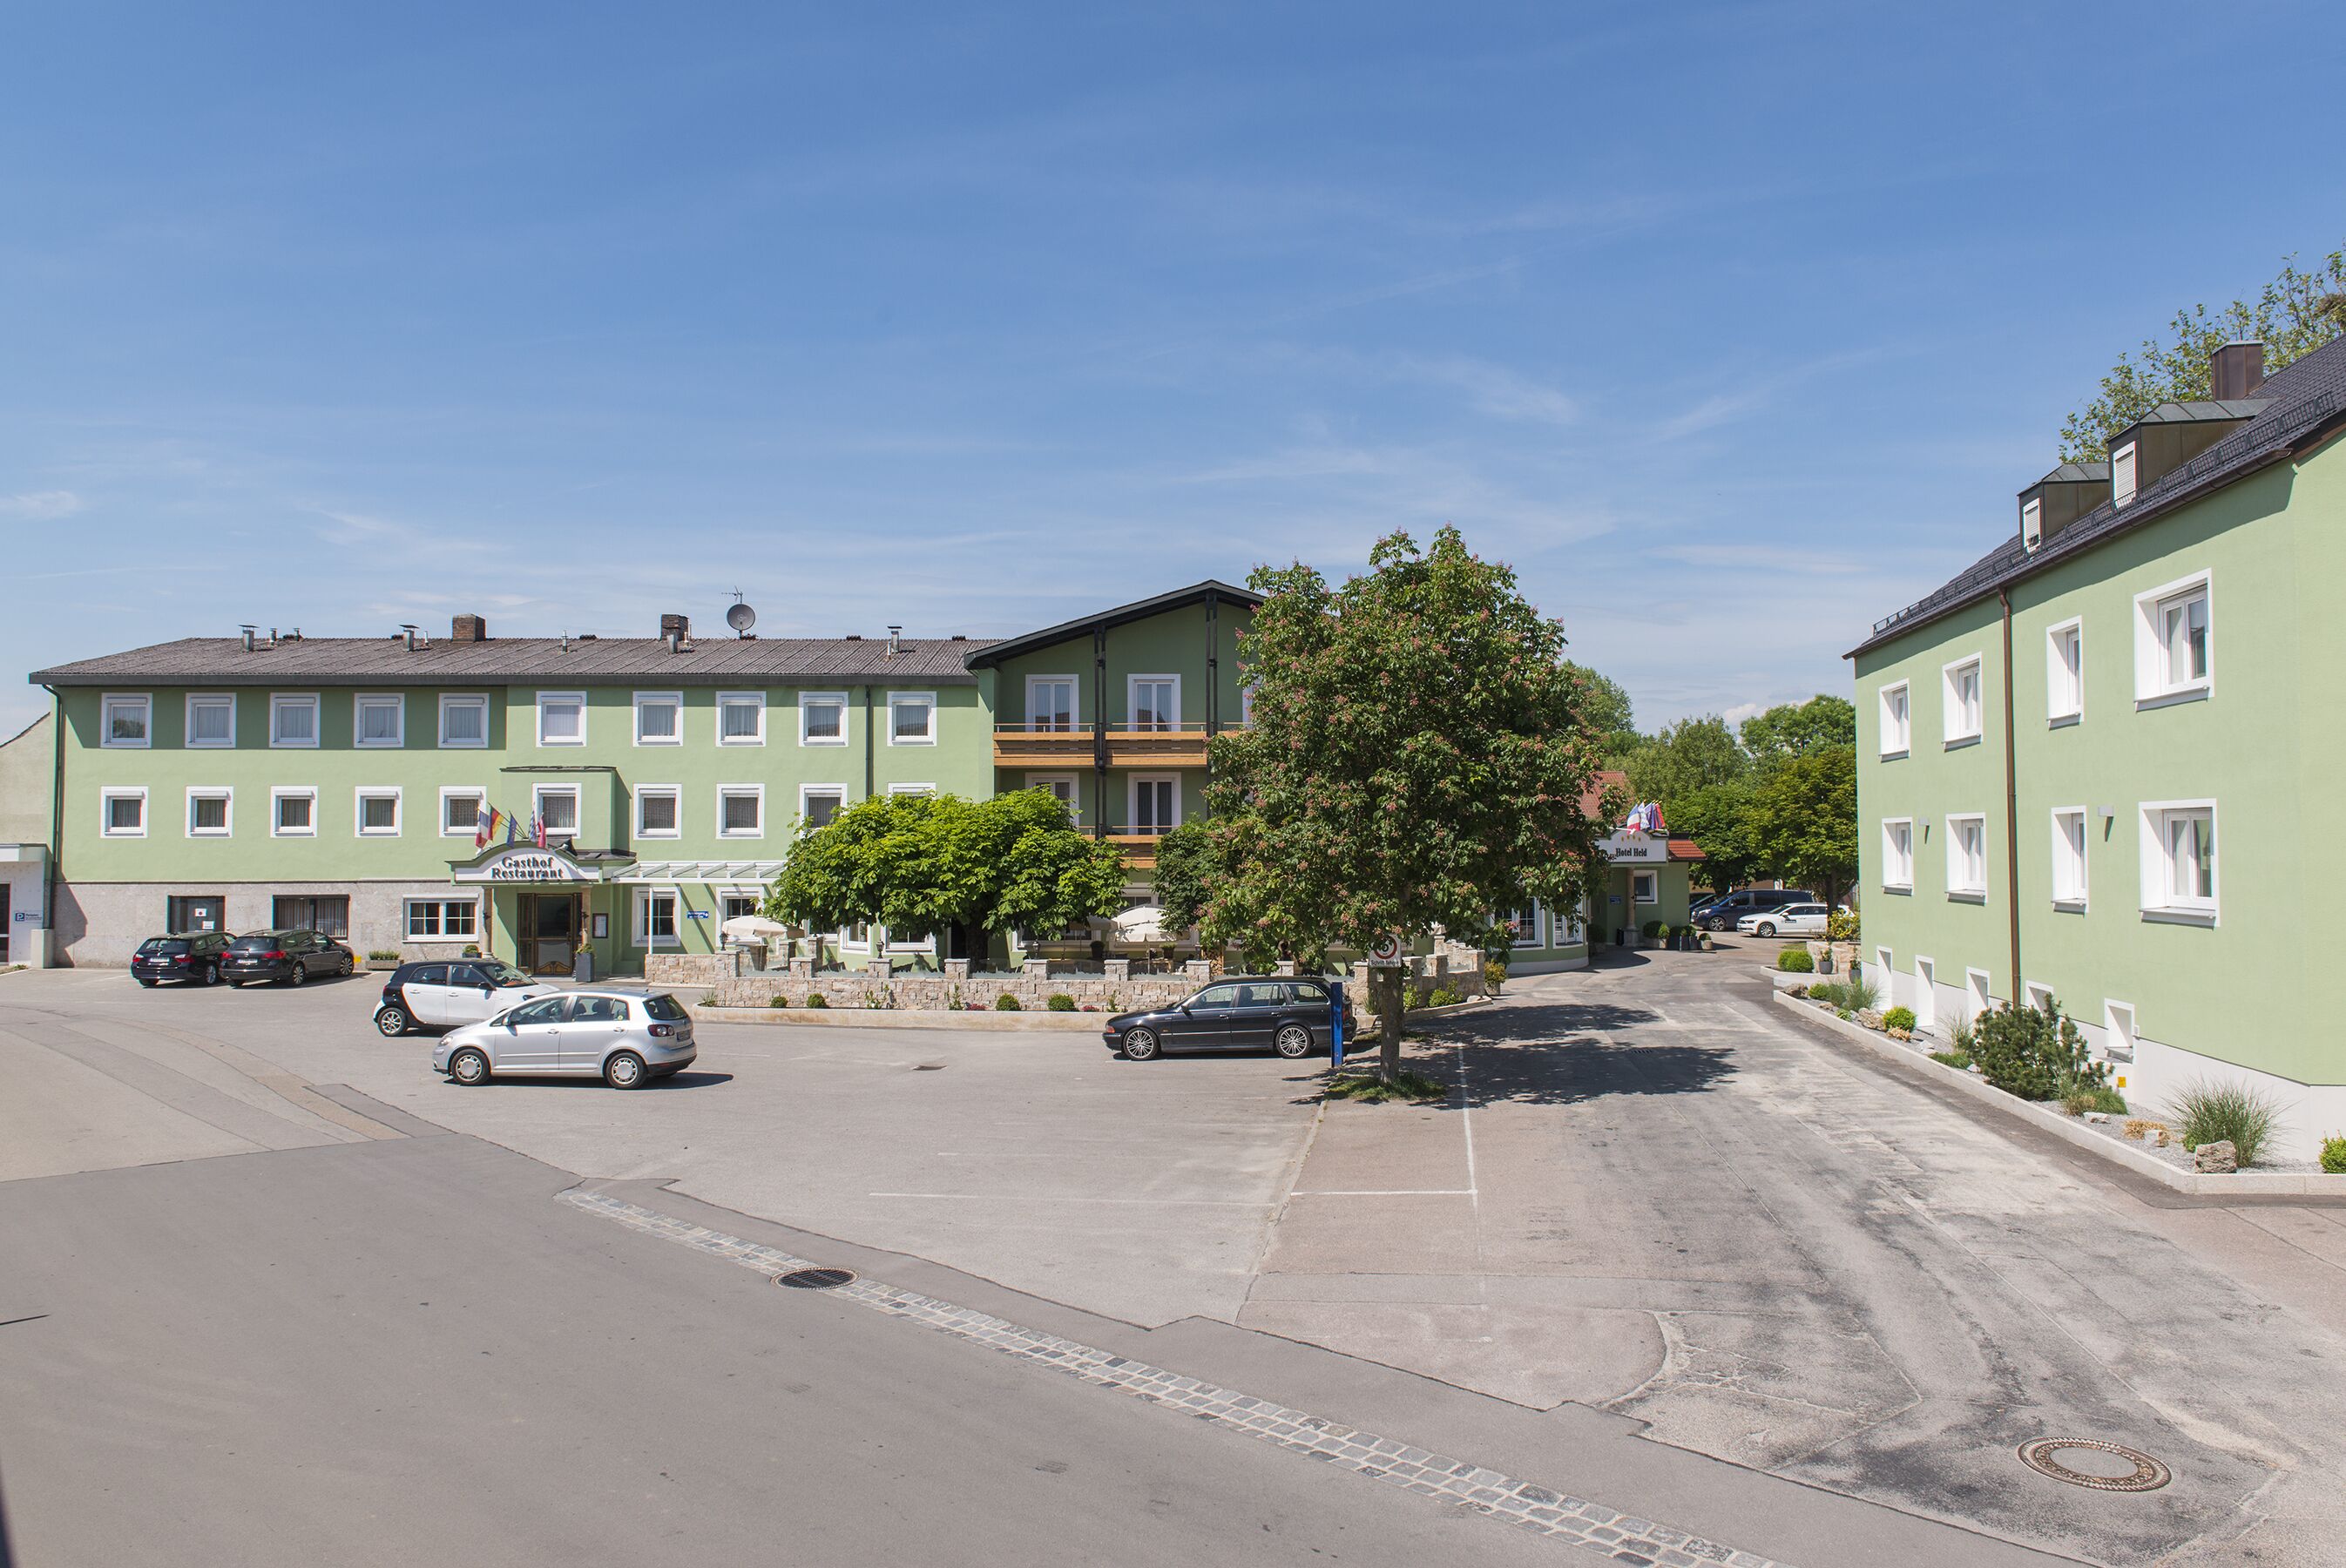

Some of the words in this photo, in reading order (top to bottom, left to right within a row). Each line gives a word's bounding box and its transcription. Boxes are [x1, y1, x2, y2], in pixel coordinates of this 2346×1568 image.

[1616, 848, 1632, 857] Hotel
[502, 856, 554, 868] Gasthof
[491, 868, 564, 879] Restaurant
